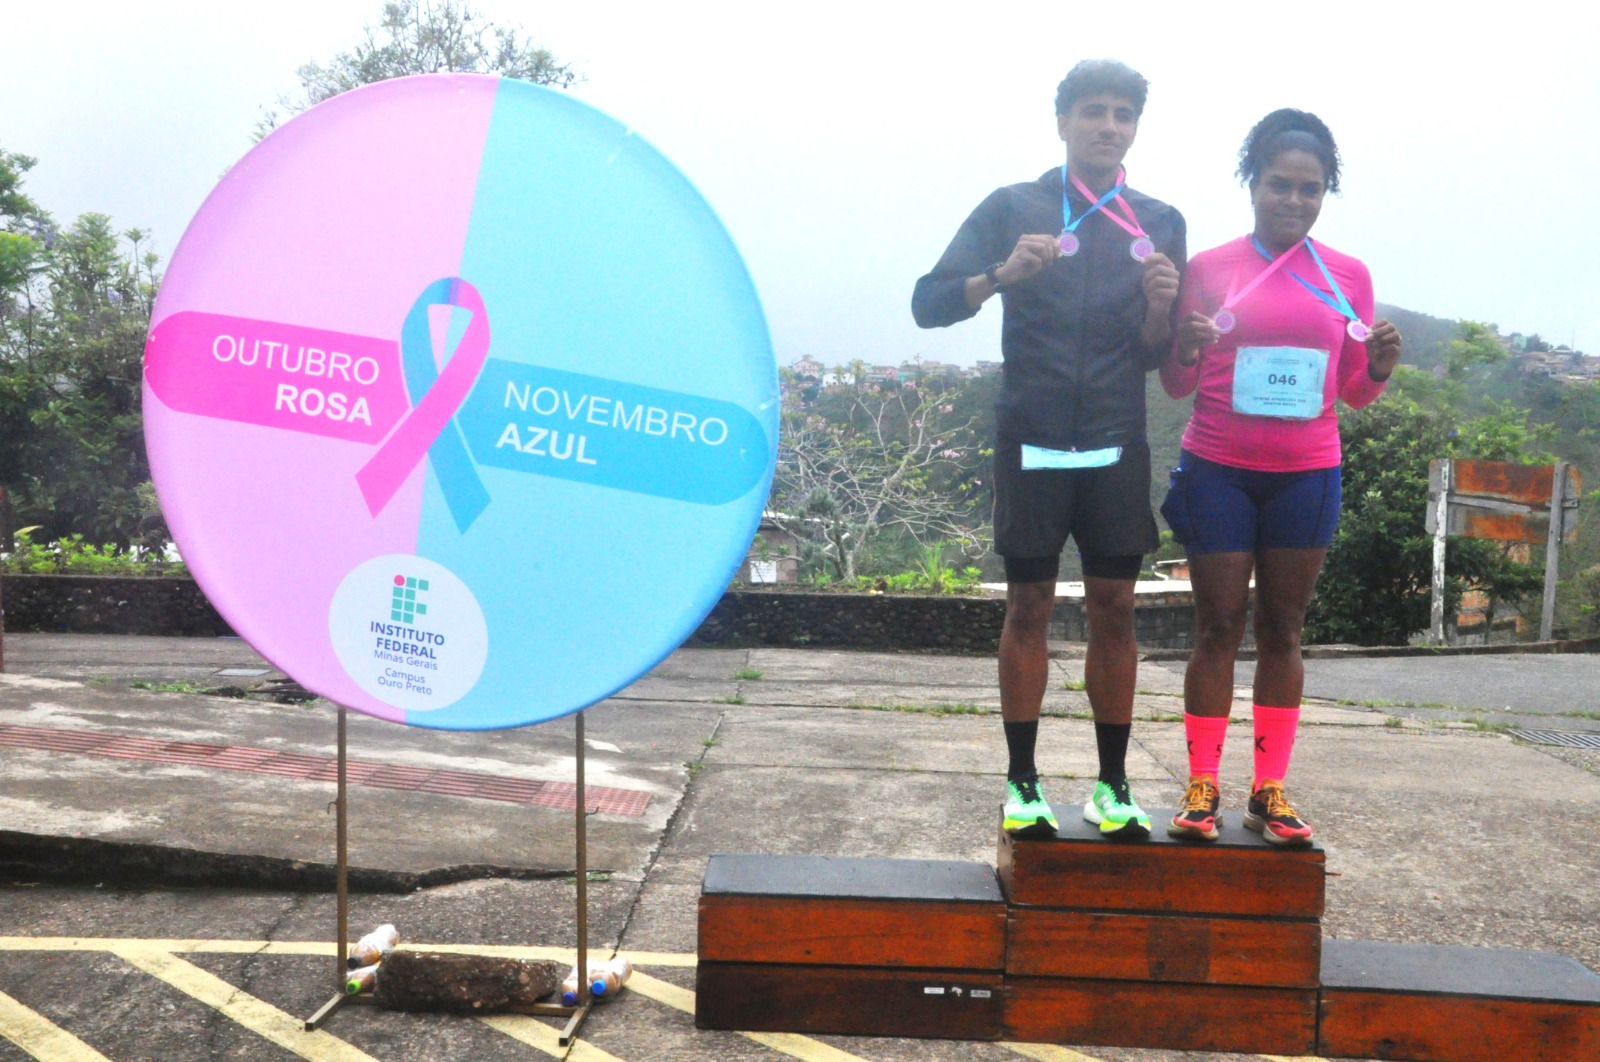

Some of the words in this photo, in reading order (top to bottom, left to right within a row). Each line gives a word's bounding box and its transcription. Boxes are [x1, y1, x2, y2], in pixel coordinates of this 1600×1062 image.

[212, 334, 380, 386] OUTUBRO
[1268, 373, 1297, 386] 046
[274, 383, 373, 427] ROSA
[503, 381, 728, 446] NOVEMBRO
[495, 423, 597, 466] AZUL
[370, 621, 445, 646] INSTITUTO
[374, 650, 404, 664] Minas
[406, 656, 438, 670] Gerais
[376, 637, 437, 660] FEDERAL
[378, 676, 403, 689] Ouro
[406, 681, 432, 695] Preto
[385, 668, 425, 684] Campus
